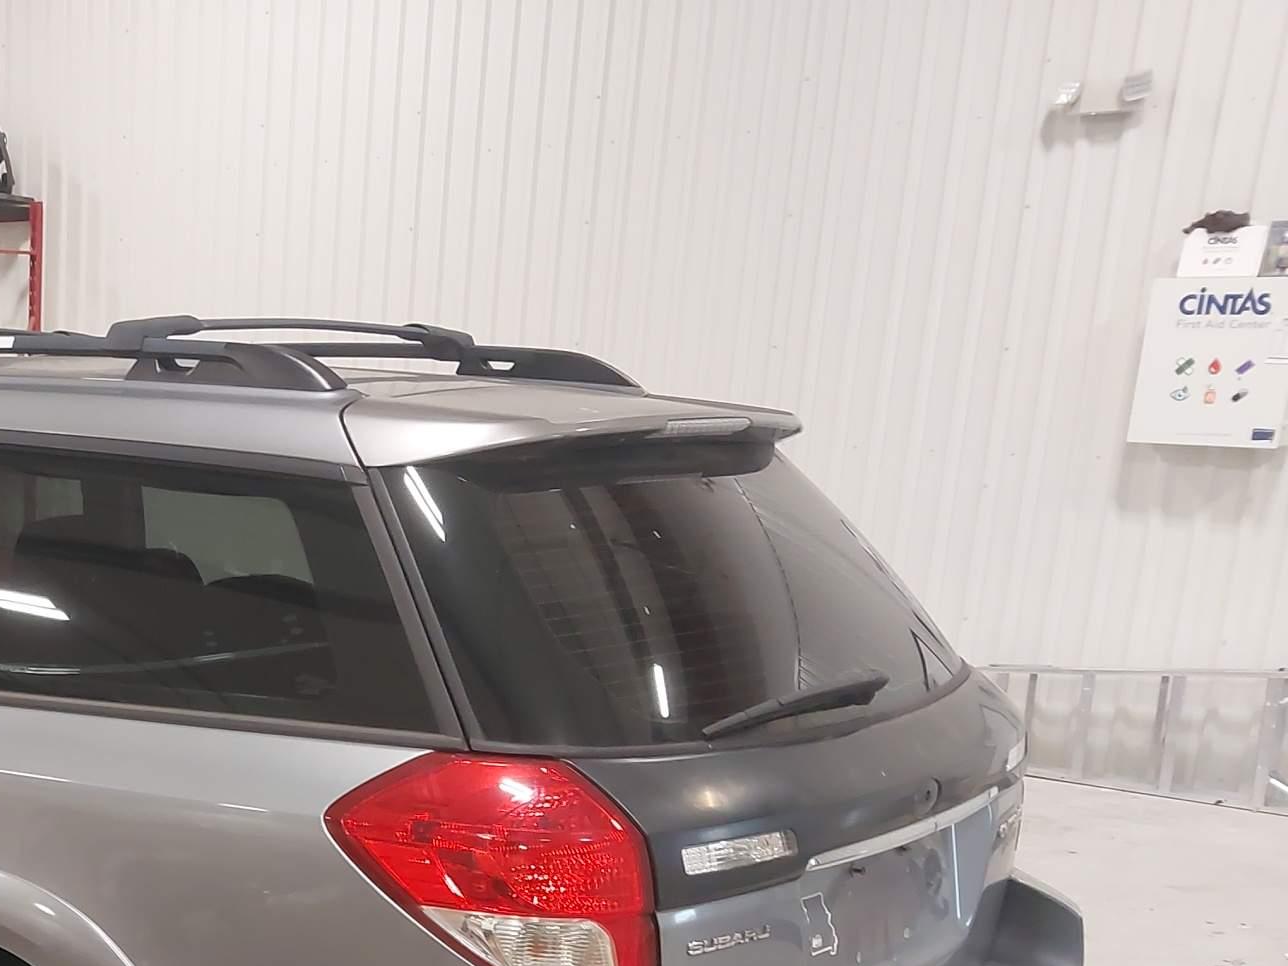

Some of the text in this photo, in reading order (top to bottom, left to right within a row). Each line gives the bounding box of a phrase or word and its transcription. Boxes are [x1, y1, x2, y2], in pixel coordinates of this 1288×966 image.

[1179, 287, 1272, 316] CINTAS
[1176, 319, 1272, 329] First Aid Center
[687, 925, 770, 955] SUBARU
